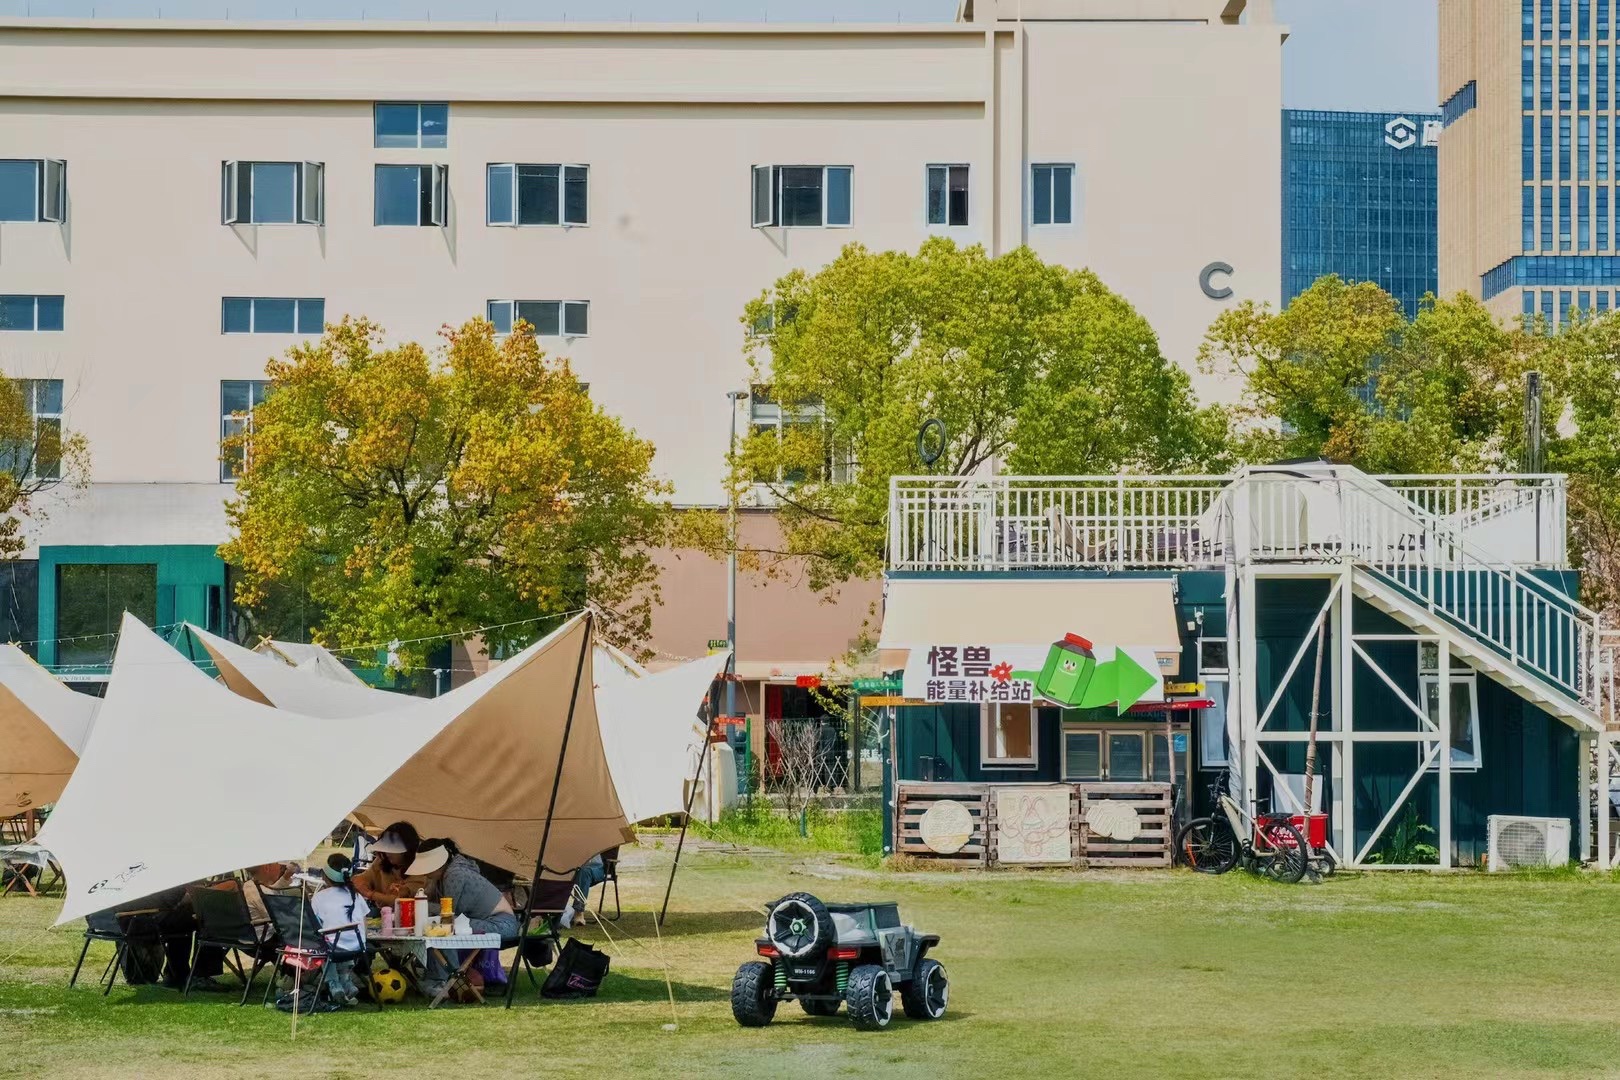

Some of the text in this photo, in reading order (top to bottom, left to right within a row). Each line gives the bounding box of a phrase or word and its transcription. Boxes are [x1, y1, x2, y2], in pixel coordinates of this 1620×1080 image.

[1199, 261, 1234, 299] C
[927, 645, 992, 677] 怪兽
[927, 679, 1032, 701] 能量补给站
